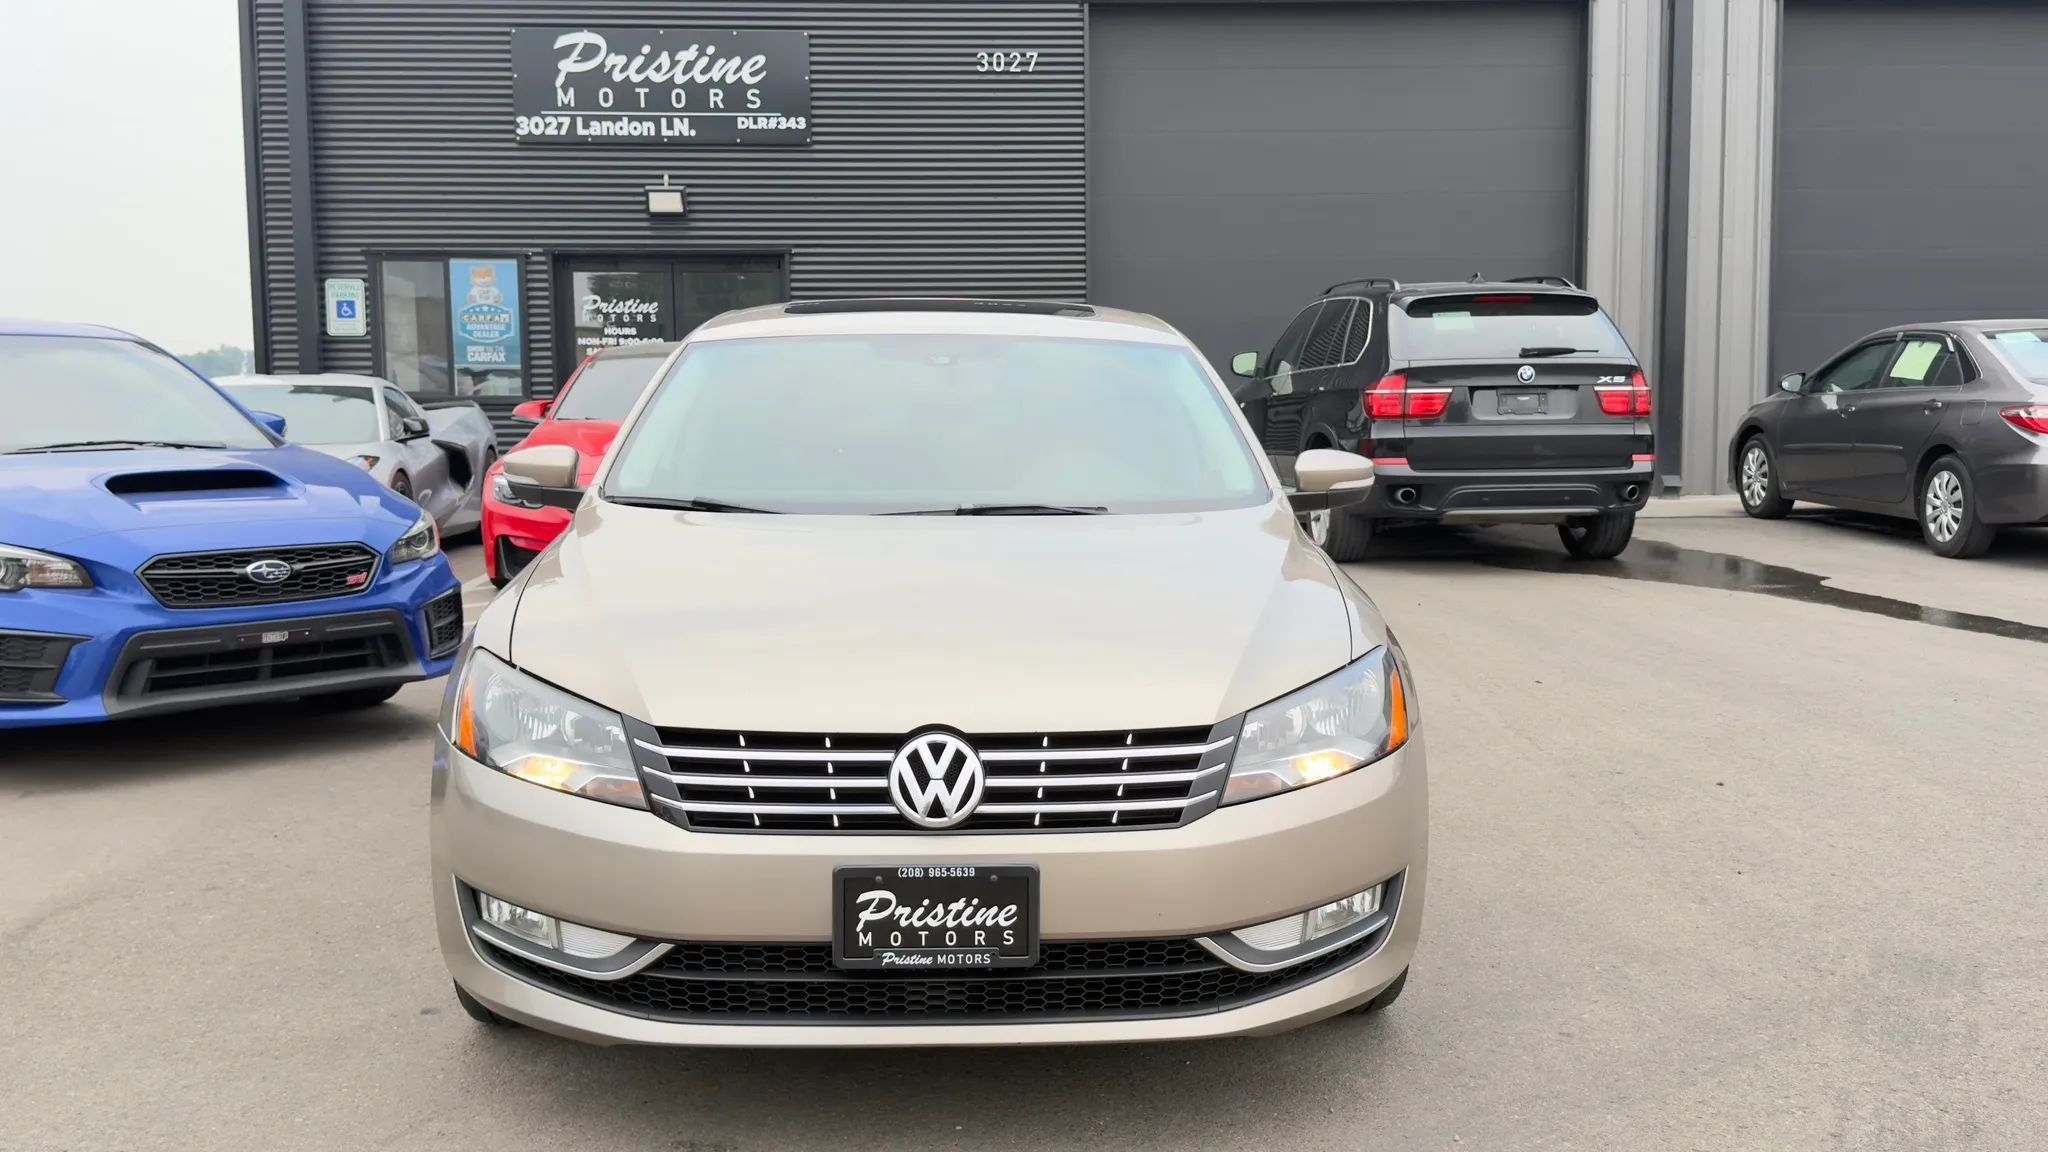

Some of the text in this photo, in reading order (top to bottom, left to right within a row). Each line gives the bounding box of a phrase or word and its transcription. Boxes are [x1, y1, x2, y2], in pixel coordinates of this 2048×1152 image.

[553, 32, 767, 88] Pristine
[976, 51, 1039, 72] 3027
[556, 87, 761, 109] MOTORS
[516, 115, 697, 137] 3027 Landon LN.
[737, 116, 807, 130] DLR#343
[582, 294, 659, 314] Pristine
[604, 327, 637, 335] HOURS
[577, 337, 617, 346] MON-FRI
[467, 351, 506, 362] CARFAX
[1596, 375, 1626, 384] X5
[897, 867, 976, 878] (208) 965-5639
[855, 890, 1018, 932] Pristine
[858, 930, 1014, 947] MOTORS
[881, 952, 991, 966] Pristine MOTORS
